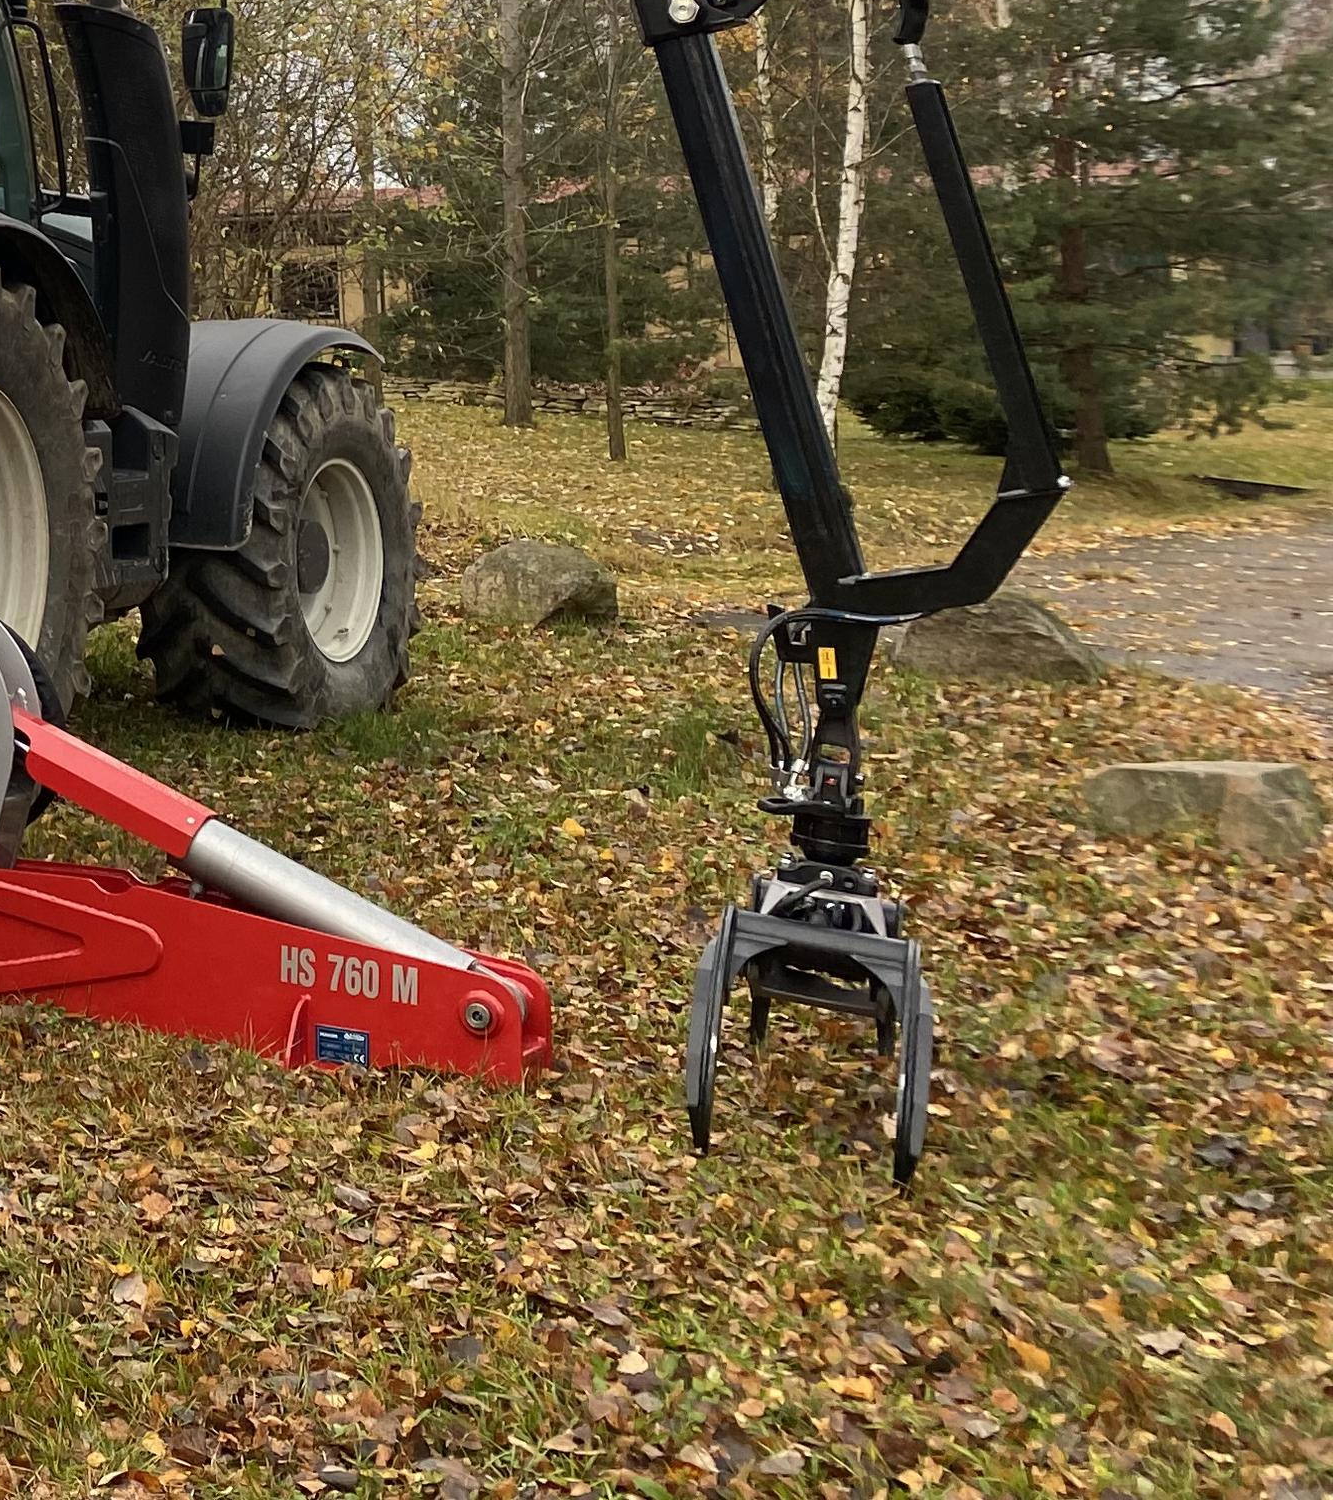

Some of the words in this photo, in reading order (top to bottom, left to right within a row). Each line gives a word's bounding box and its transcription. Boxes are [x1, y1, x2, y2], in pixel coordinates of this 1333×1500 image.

[280, 945, 316, 988] HS
[327, 953, 380, 999] 760
[392, 963, 419, 1006] M
